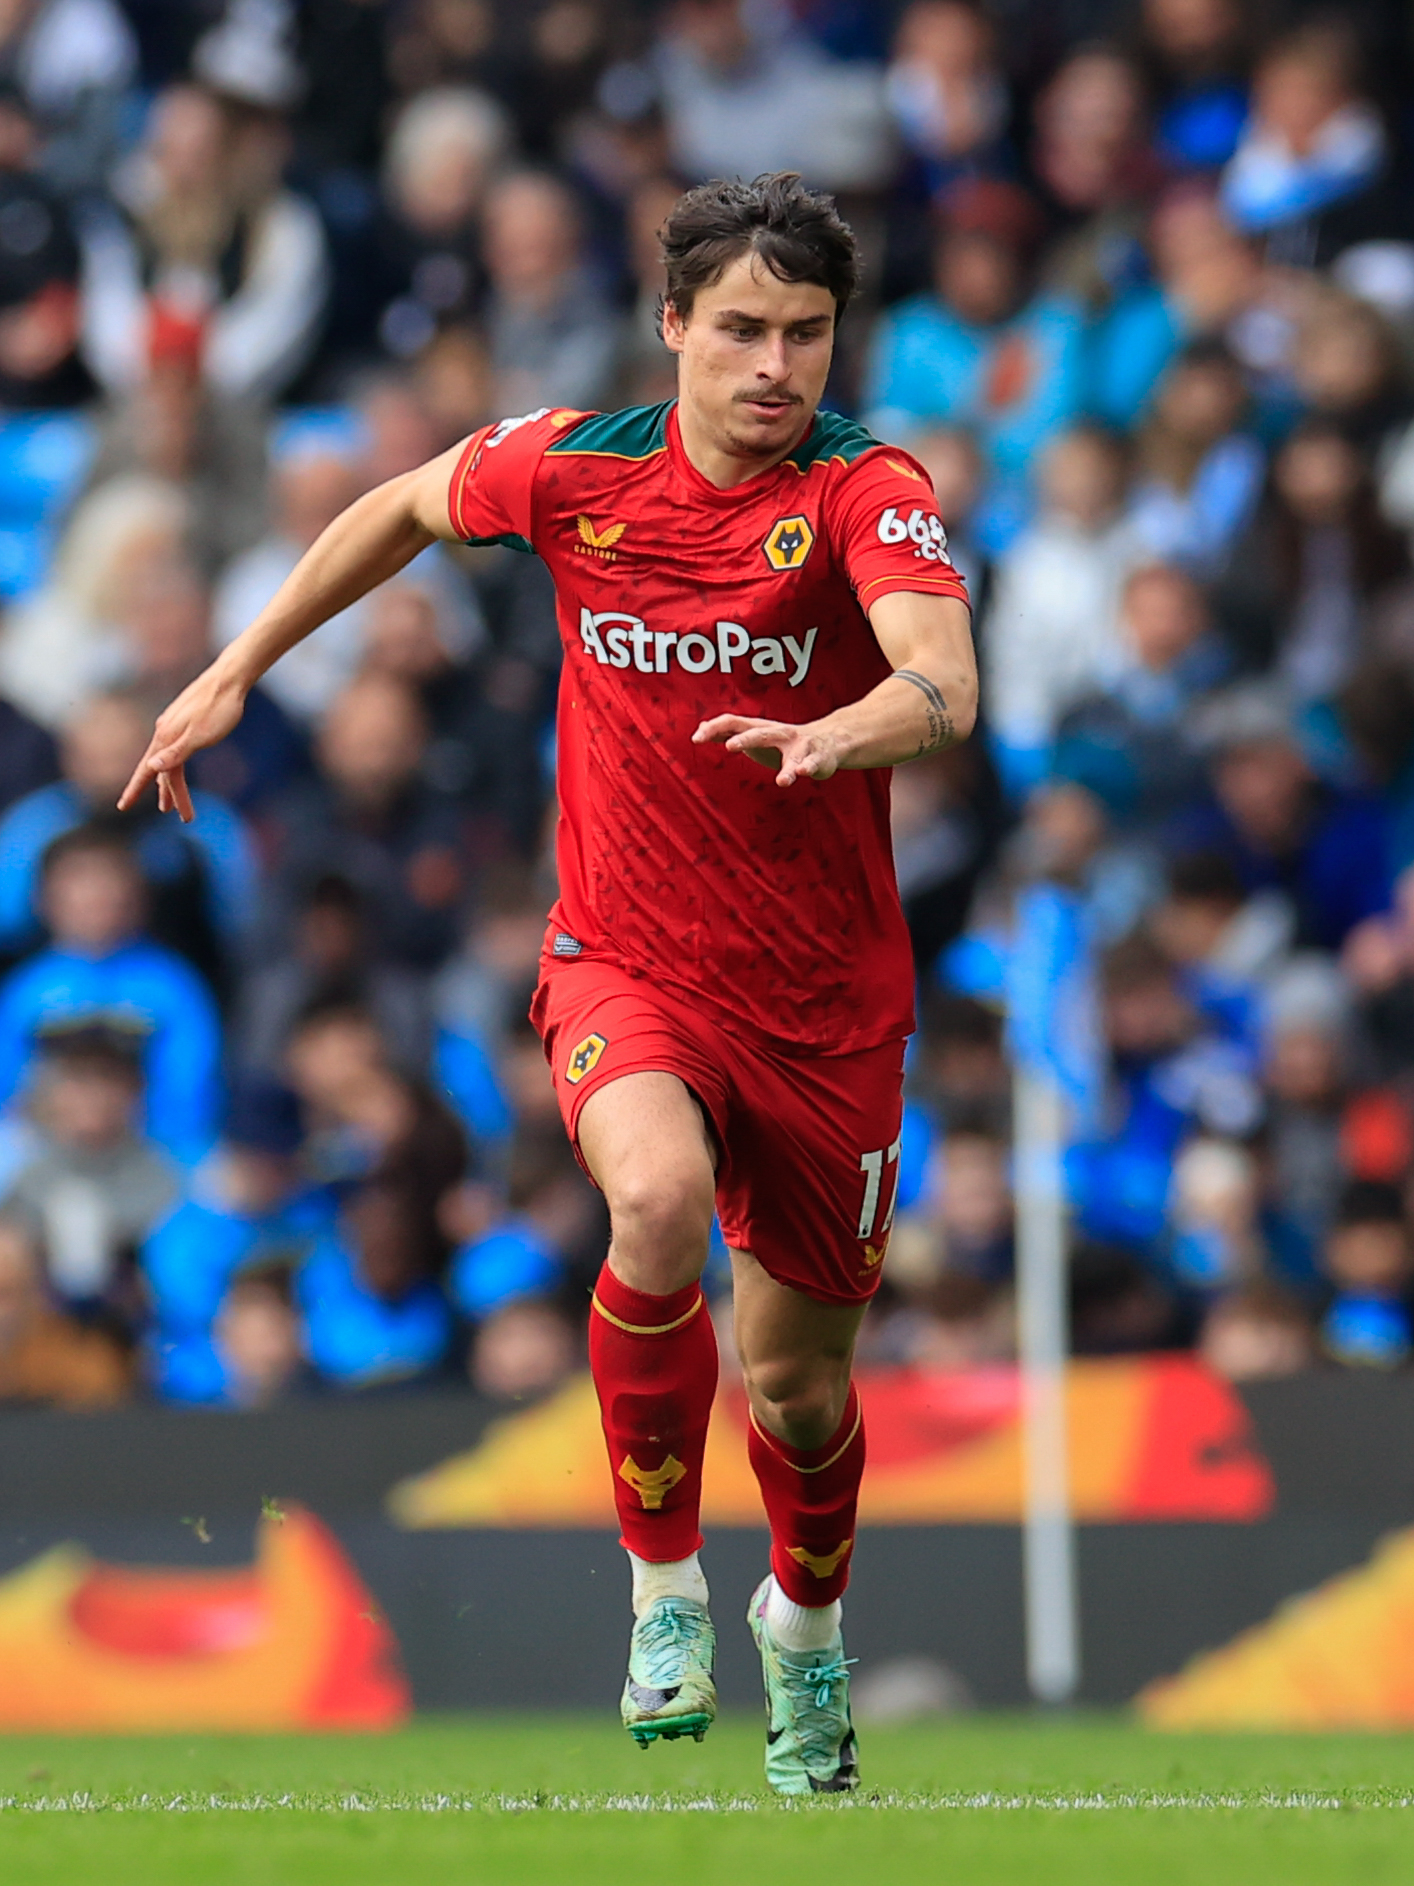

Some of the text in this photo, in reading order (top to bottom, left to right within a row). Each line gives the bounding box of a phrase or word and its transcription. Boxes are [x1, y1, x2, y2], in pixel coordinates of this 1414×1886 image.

[877, 507, 948, 549] 668
[573, 544, 618, 562] CASTORE
[580, 607, 819, 688] AstroPay
